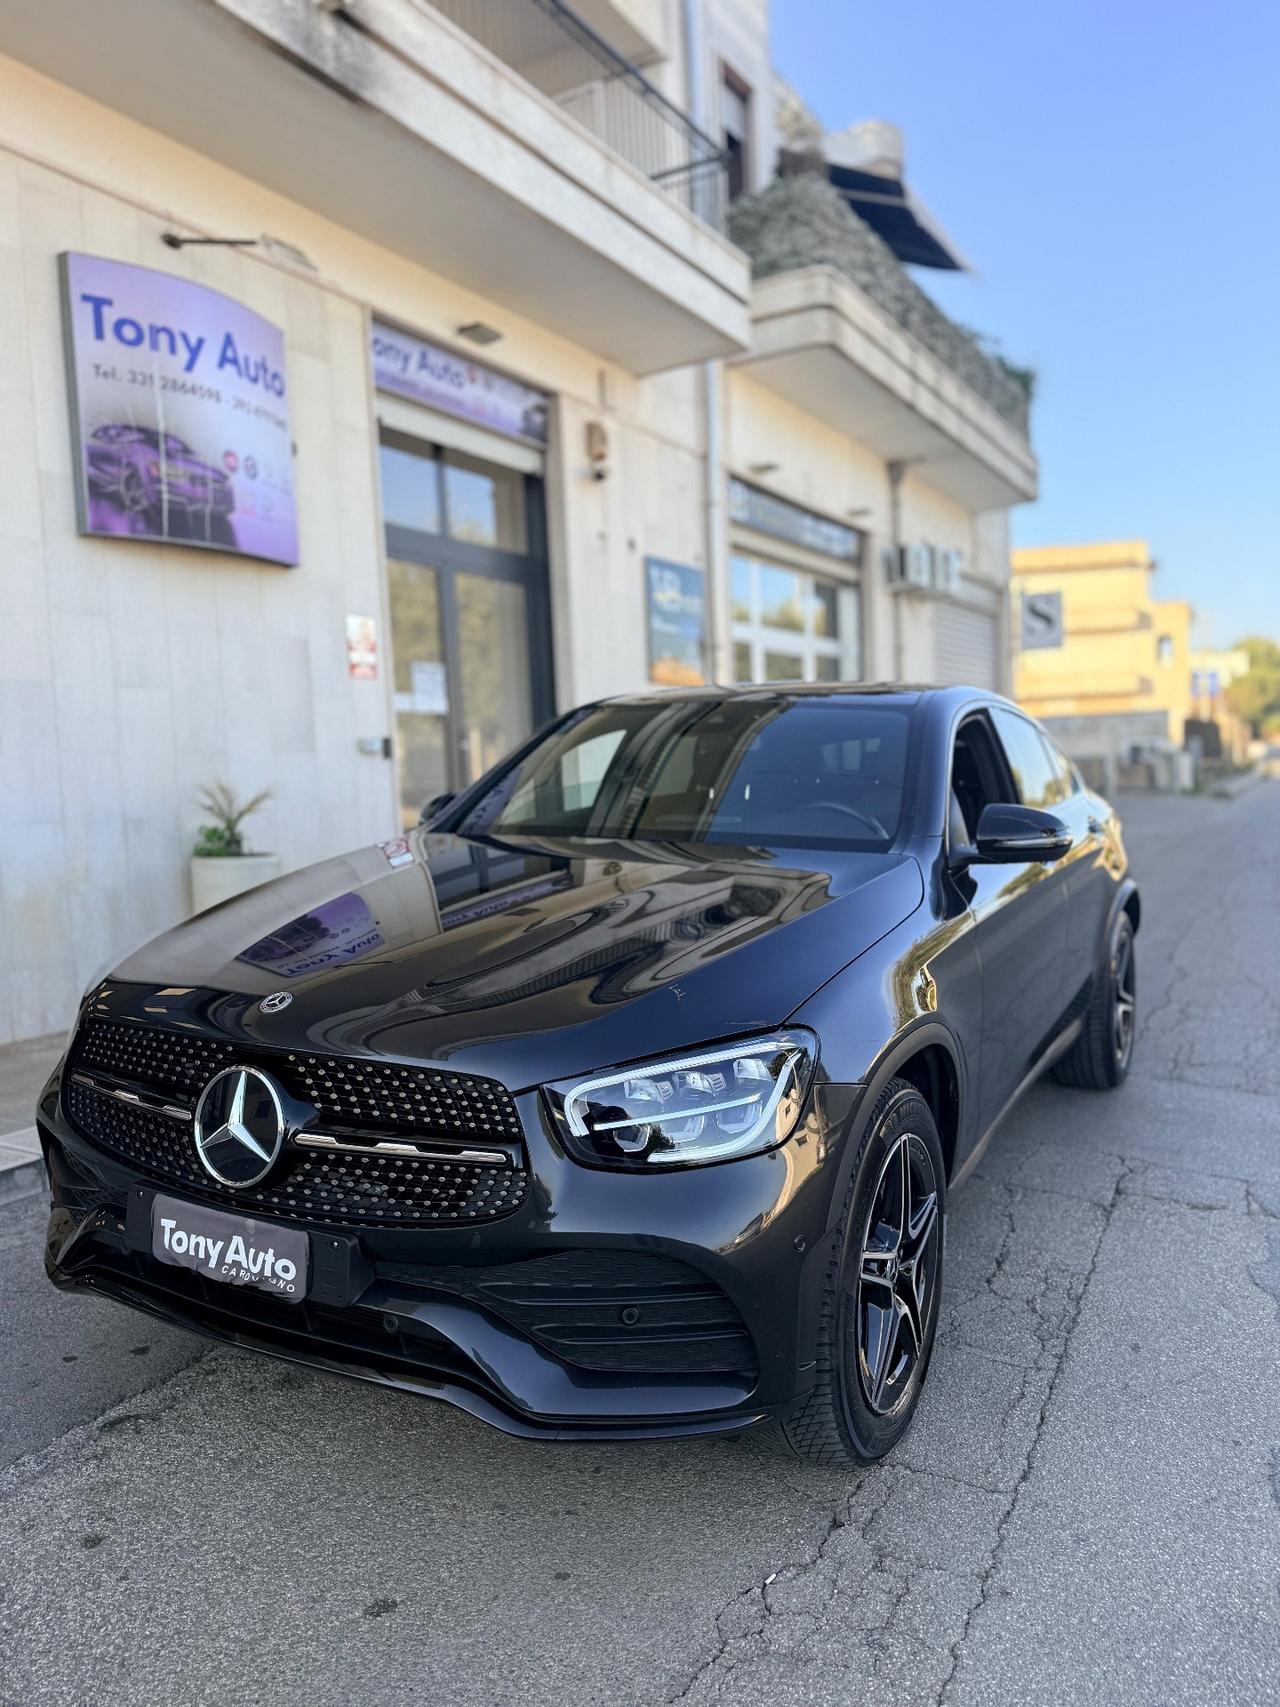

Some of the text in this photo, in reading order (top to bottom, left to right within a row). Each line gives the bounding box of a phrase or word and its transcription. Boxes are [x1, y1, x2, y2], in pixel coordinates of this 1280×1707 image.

[81, 293, 285, 398] Tony Auto
[373, 337, 466, 389] ony Auto
[160, 1218, 297, 1281] Tony Auto
